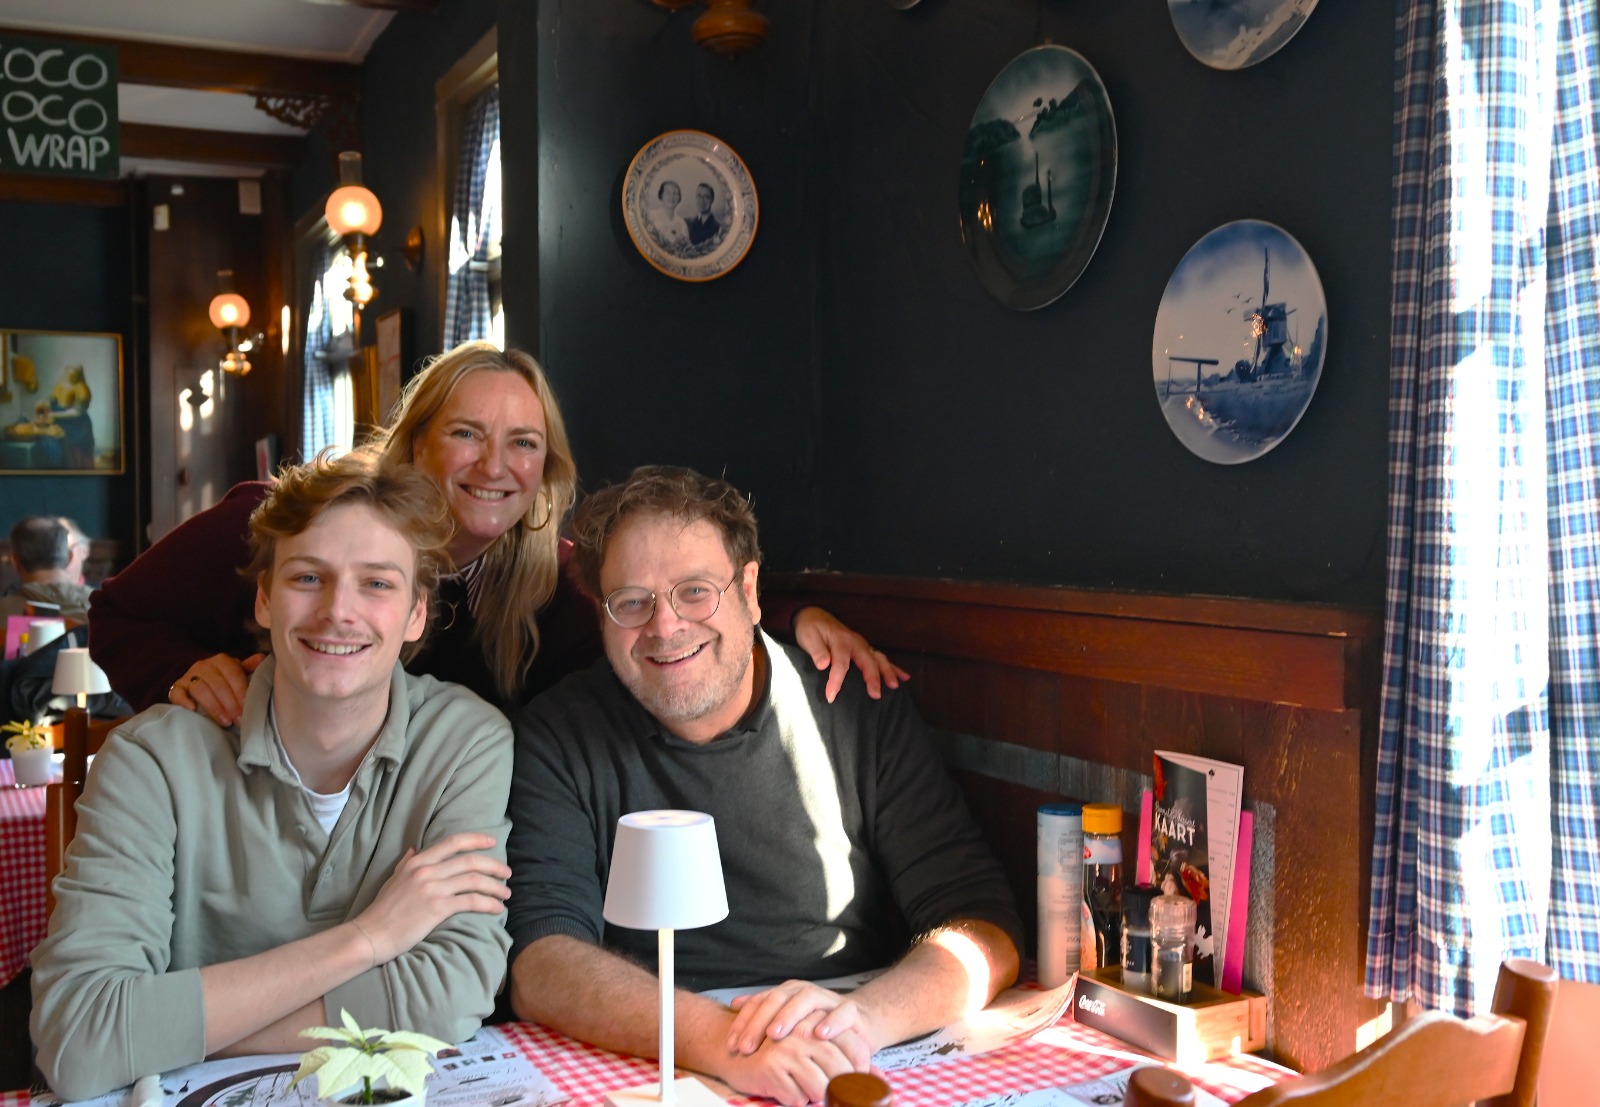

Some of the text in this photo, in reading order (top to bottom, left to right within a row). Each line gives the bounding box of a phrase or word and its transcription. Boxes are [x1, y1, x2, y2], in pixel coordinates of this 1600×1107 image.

[0, 44, 108, 91] OCO
[7, 127, 110, 172] WRAP
[1154, 811, 1196, 847] KAART
